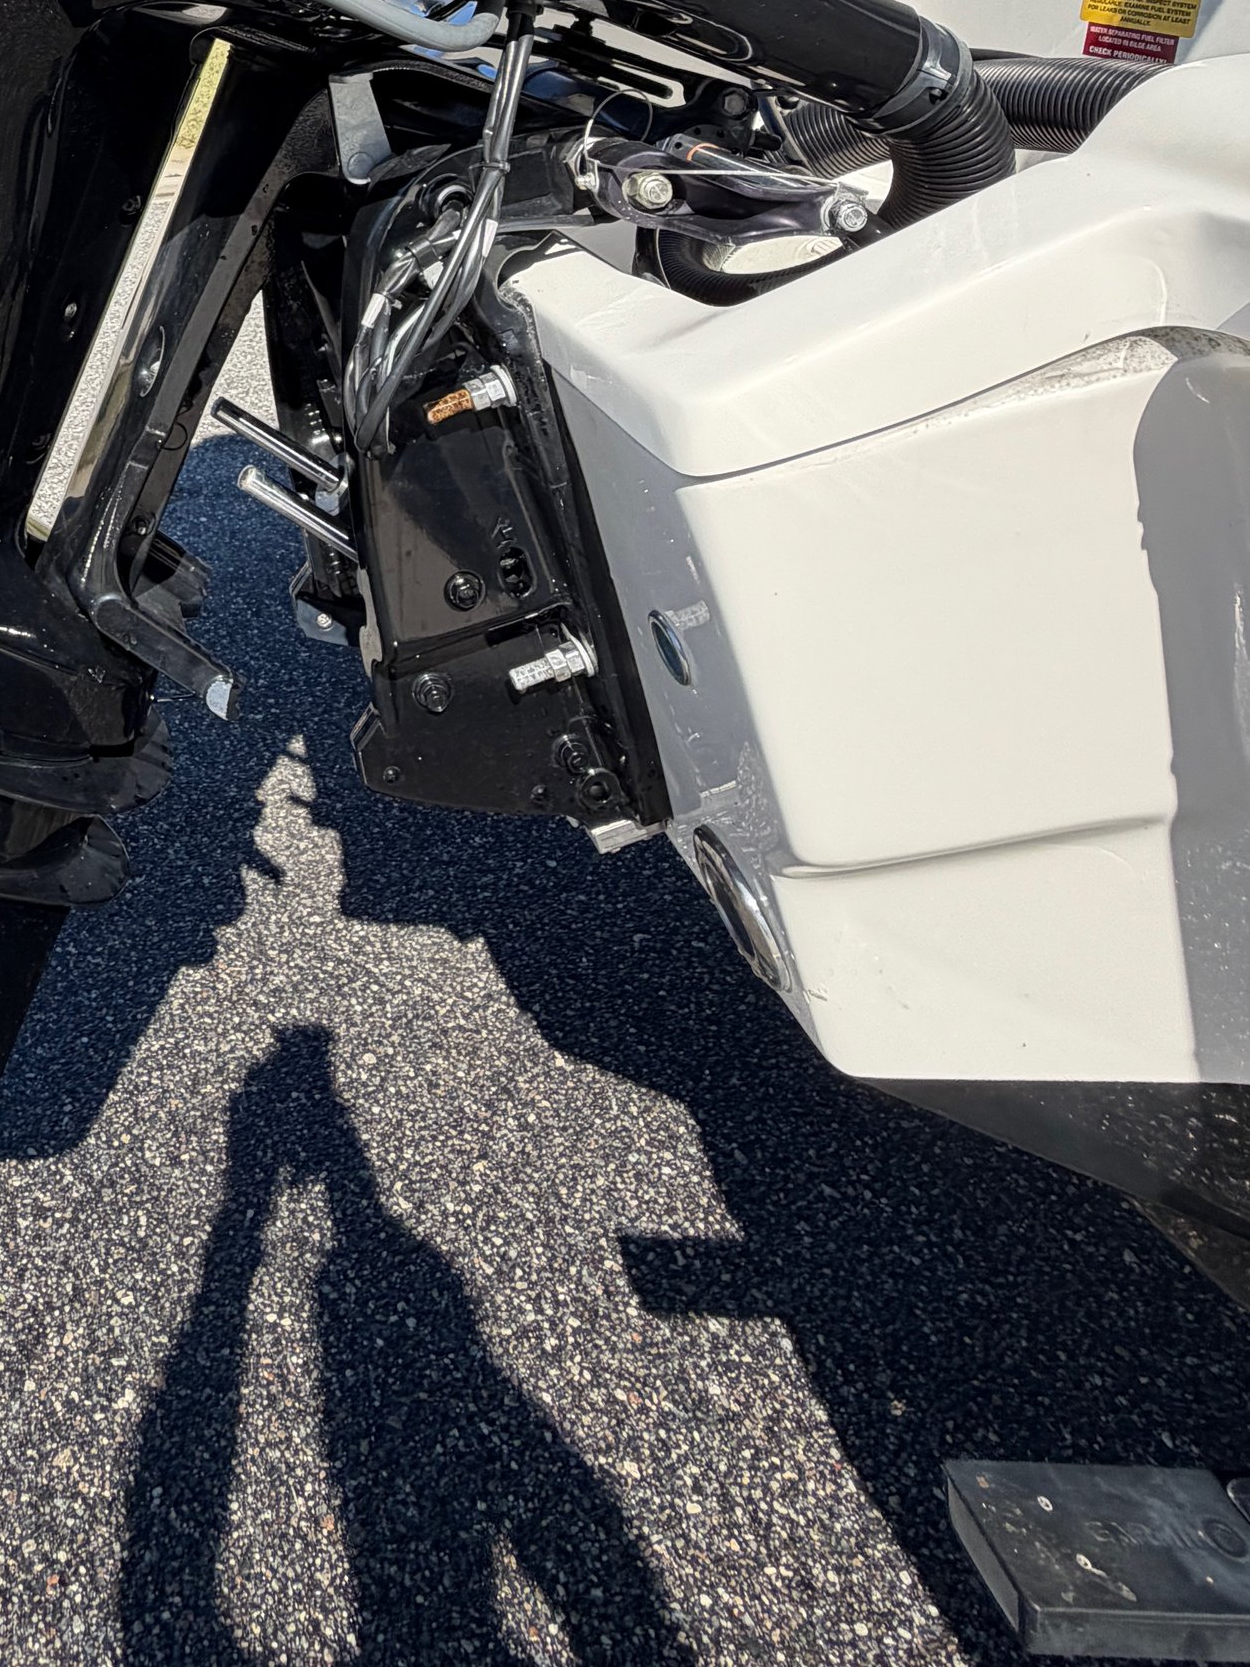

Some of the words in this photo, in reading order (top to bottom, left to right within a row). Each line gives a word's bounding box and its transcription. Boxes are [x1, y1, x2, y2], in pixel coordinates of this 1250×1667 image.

[1124, 2, 1150, 10] EXAMINE
[1150, 5, 1165, 13] FUEL
[1166, 8, 1191, 17] SYSTEM
[1171, 1, 1197, 10] SYSTEM
[1100, 5, 1117, 14] LEAKS
[1127, 9, 1162, 20] CORROSION
[1171, 16, 1191, 25] LEAST
[1090, 25, 1108, 34] WATER
[1108, 28, 1141, 40] SEPARATING
[1141, 34, 1155, 43] FUEL
[1155, 36, 1175, 46] FILTER
[1098, 35, 1122, 45] LOCATED
[1128, 40, 1146, 50] BILGE
[1145, 43, 1162, 52] AREA
[1089, 45, 1112, 56] CHECK
